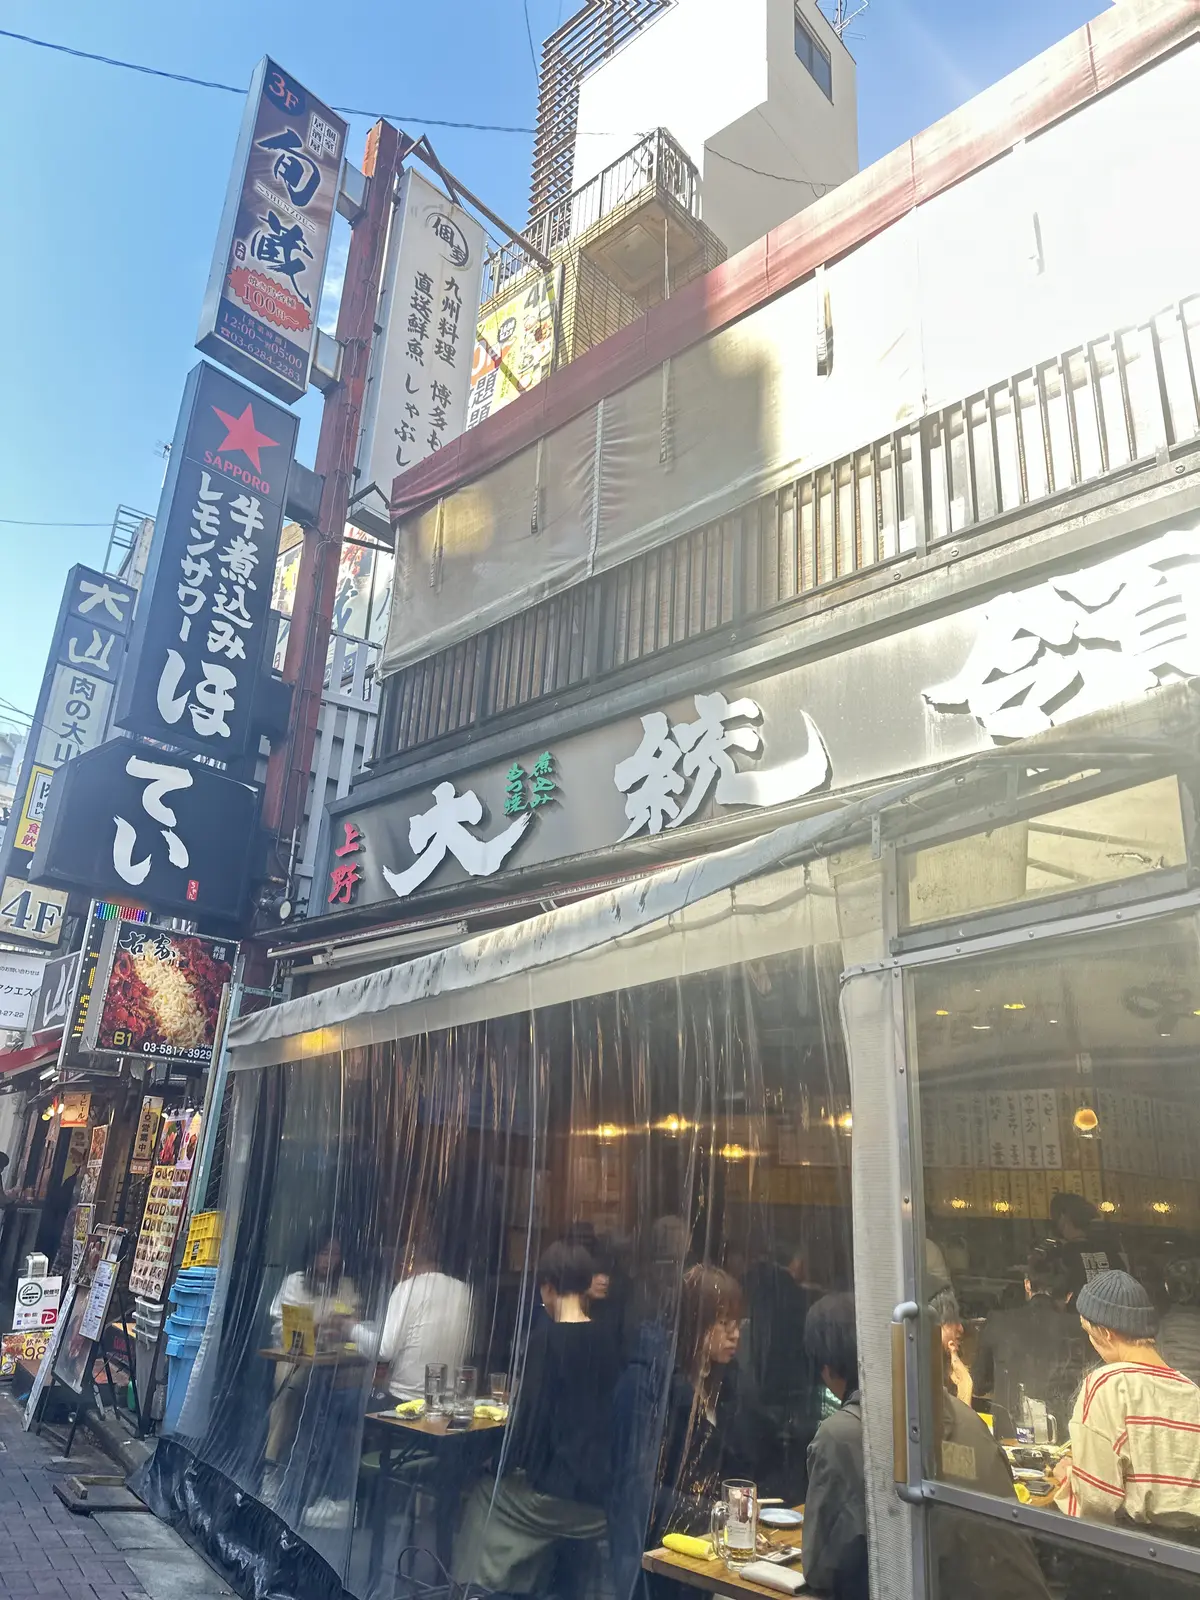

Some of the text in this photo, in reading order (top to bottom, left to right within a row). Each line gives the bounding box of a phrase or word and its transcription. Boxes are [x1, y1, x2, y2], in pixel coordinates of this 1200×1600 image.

[269, 72, 299, 110] 3F
[432, 216, 468, 267] 個室
[405, 270, 434, 367] 直送鮮魚
[433, 275, 463, 369] 九州料理
[203, 449, 271, 495] SAPPORO
[178, 471, 224, 642] レモンサワー
[206, 493, 265, 661] 牛煮込み
[69, 580, 131, 672] 大山
[504, 762, 527, 815] もつ焼
[529, 751, 556, 809] 煮込み
[328, 822, 361, 904] 上野
[1, 889, 62, 934] 4F
[113, 1031, 132, 1046] B1
[143, 1042, 212, 1060] 03-5817-3929
[138, 1123, 151, 1153] 営業中
